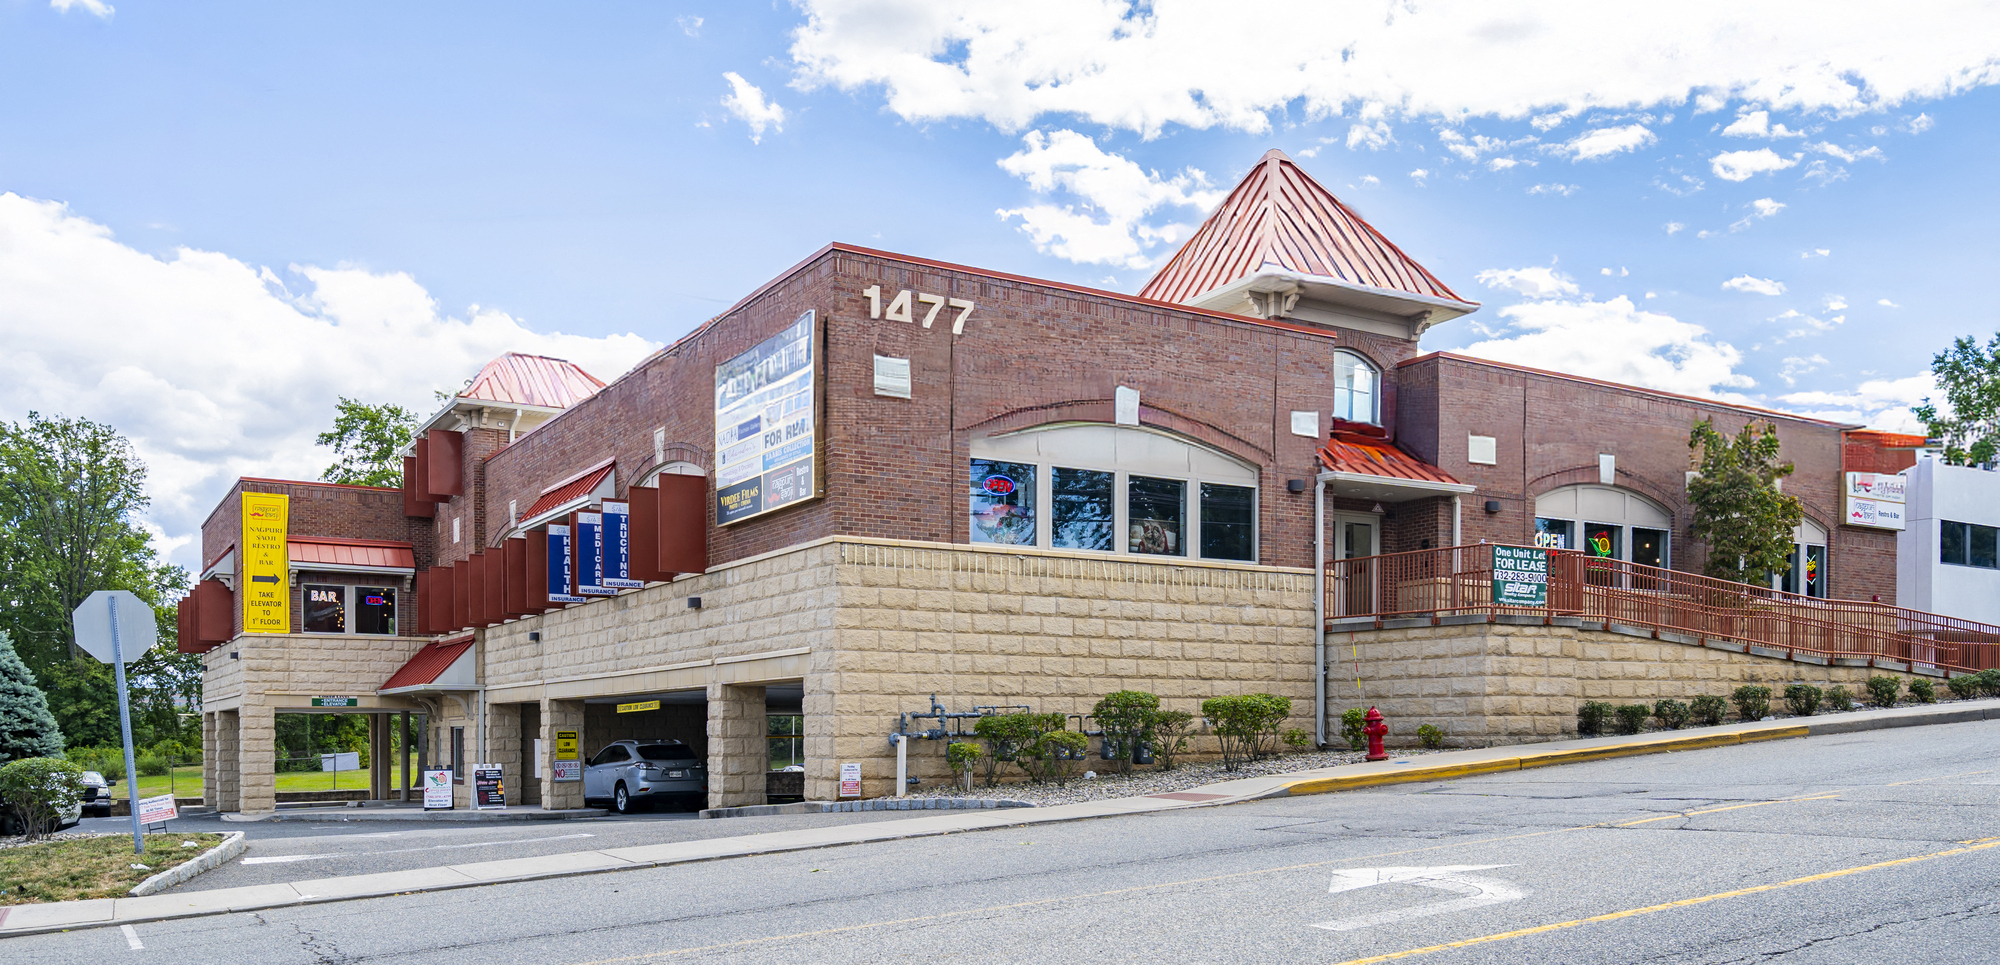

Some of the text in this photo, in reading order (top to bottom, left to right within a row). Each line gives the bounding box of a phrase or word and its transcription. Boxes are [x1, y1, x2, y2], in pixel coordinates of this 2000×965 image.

[863, 284, 974, 334] 1477
[764, 428, 782, 448] FOR
[796, 465, 809, 476] Restro
[985, 478, 1013, 493] OPEN
[720, 486, 759, 507] VIRDEE FILMS
[1534, 531, 1565, 549] OPEN
[1496, 547, 1511, 557] One
[1513, 549, 1530, 559] Unit
[1496, 558, 1546, 572] FOR LEASE
[311, 590, 337, 602] BAR
[555, 769, 565, 778] NO
